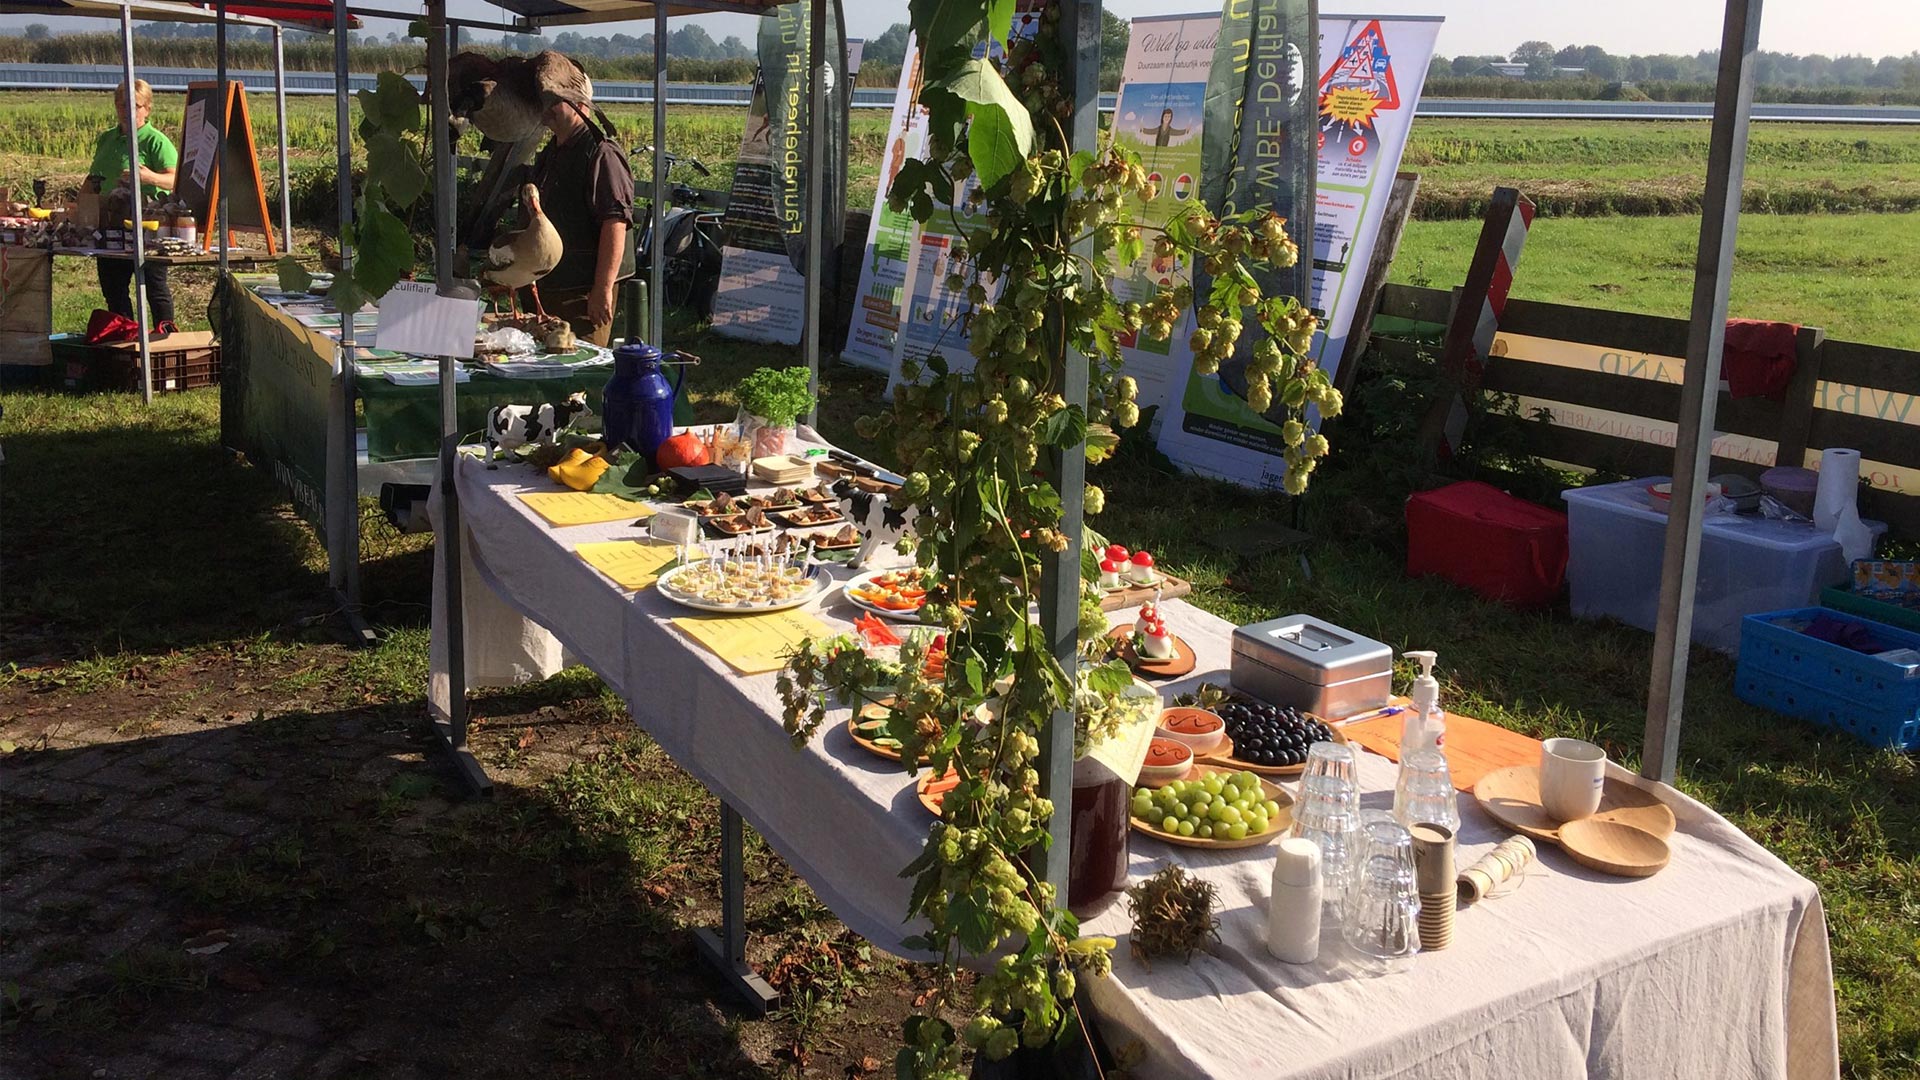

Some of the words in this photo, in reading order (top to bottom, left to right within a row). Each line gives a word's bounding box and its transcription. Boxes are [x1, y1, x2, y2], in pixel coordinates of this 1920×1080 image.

[1141, 32, 1179, 53] Wild
[1137, 61, 1165, 70] Duurzaam
[394, 282, 431, 294] Culiflair
